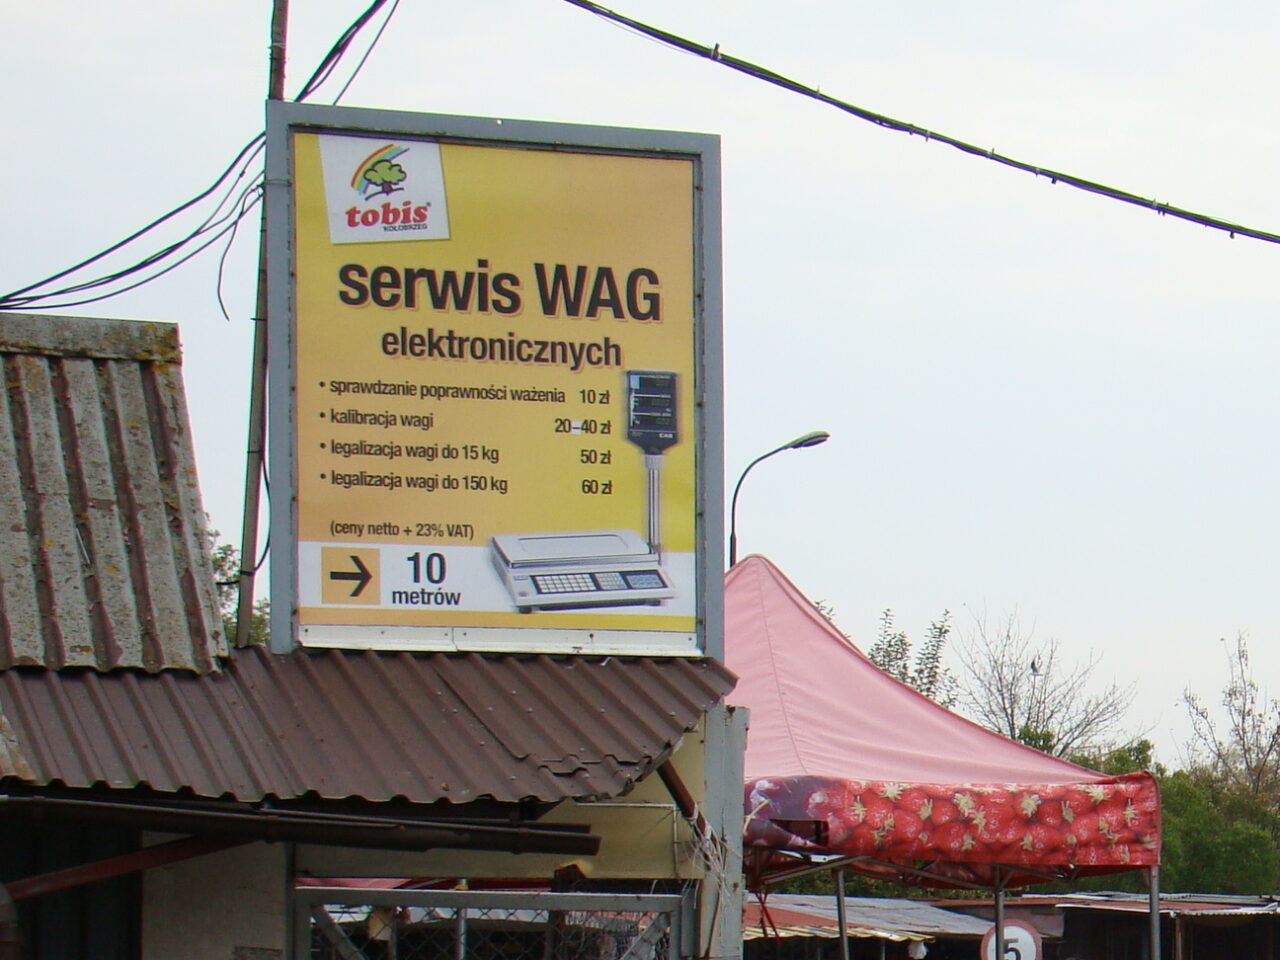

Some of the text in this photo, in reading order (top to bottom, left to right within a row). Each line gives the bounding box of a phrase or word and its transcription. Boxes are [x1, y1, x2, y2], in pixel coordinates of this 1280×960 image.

[345, 200, 428, 228] tobis
[338, 259, 661, 322] serwis WAG
[381, 327, 622, 371] elektronicznych
[330, 380, 610, 405] sprawdzanie poprawności ważenia 10 zł
[330, 408, 397, 428] kalibracja
[400, 413, 433, 431] wagi
[600, 420, 612, 435] zł
[330, 439, 612, 465] legalizacja wagi do 15 kg 50 zł
[331, 470, 613, 495] legalizacja wagi do 150 kg 60 zł
[330, 520, 474, 541] (ceny netto + 23% VAT)
[407, 552, 447, 584] 10
[392, 588, 461, 606] metrów
